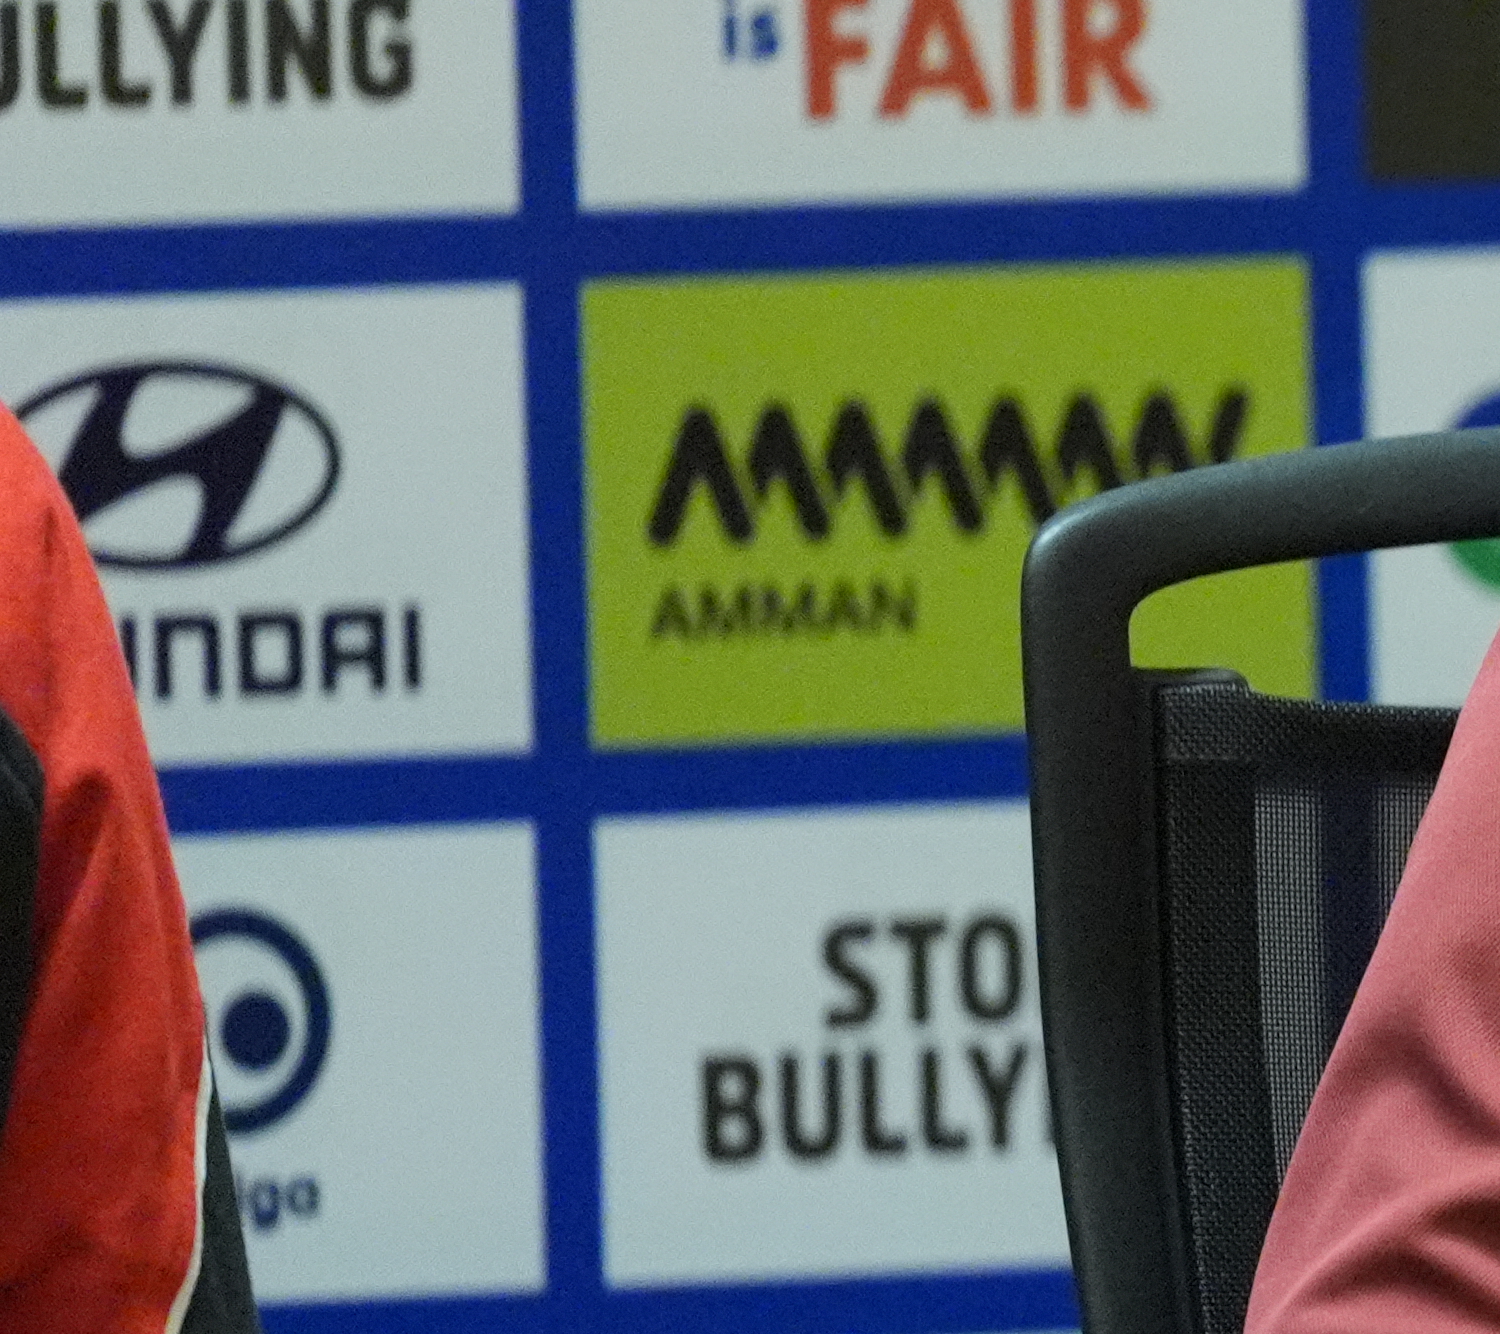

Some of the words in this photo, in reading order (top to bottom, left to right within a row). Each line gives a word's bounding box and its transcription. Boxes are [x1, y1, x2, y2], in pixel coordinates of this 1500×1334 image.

[122, 603, 423, 701] NDAI
[649, 581, 918, 643] AMMAN
[822, 914, 1024, 1028] STO
[703, 1043, 1054, 1163] BULLY
